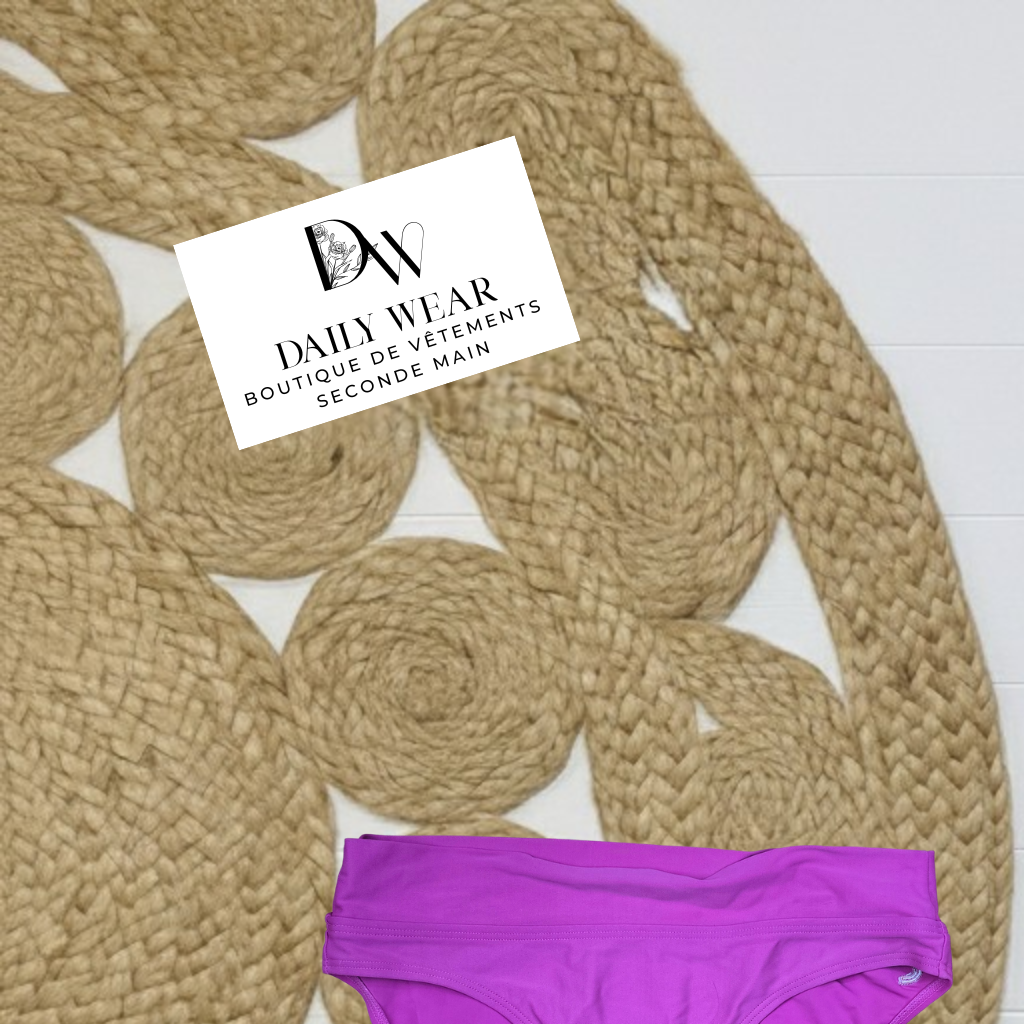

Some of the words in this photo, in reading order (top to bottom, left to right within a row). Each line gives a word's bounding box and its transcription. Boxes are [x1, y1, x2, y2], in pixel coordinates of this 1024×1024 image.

[244, 358, 361, 407] BOUTIQUE
[371, 345, 401, 366] DE
[408, 299, 541, 352] VÊTEMENTS
[274, 313, 375, 371] DAILY
[385, 277, 499, 332] WEAR
[316, 363, 424, 408] SECONDE
[432, 341, 490, 371] MAIN
